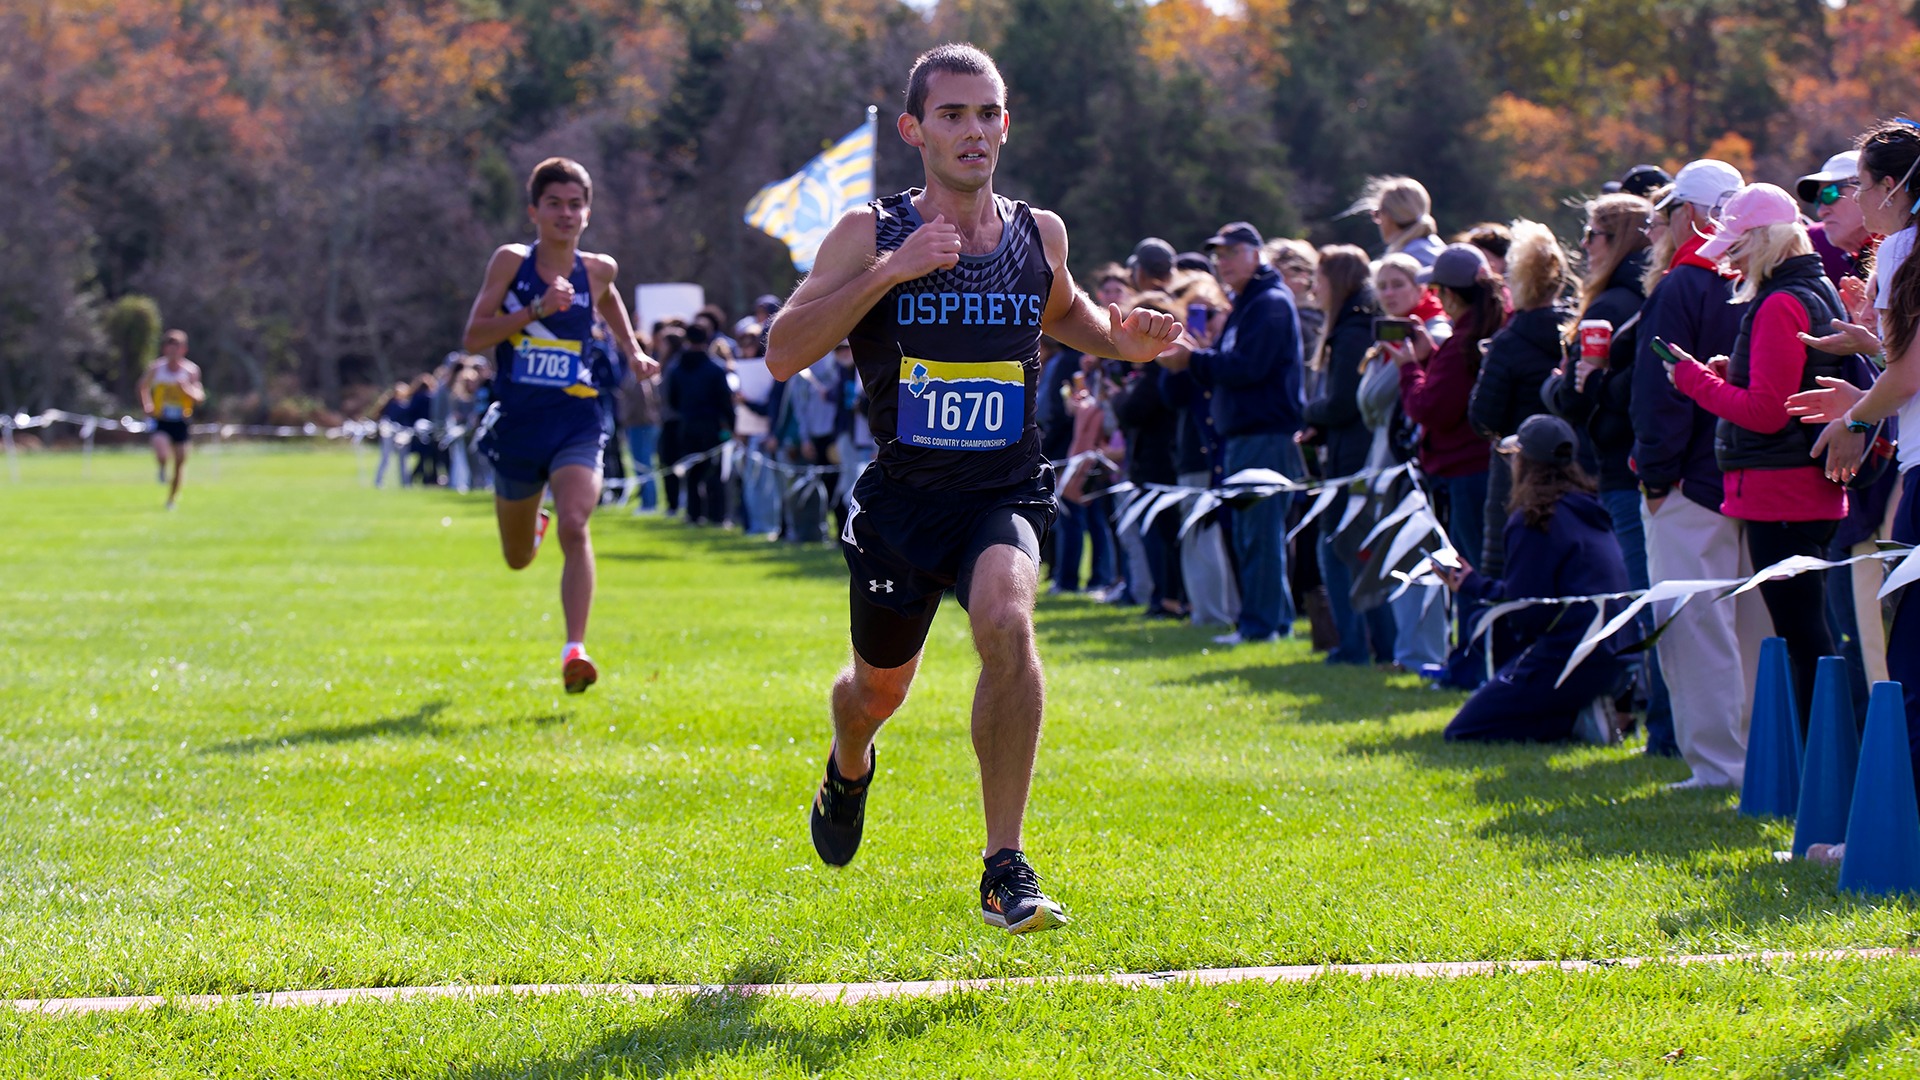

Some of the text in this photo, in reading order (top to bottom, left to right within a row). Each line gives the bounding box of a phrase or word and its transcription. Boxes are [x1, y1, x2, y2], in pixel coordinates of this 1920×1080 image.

[897, 292, 1042, 326] OSPREYS
[527, 351, 571, 379] 1703
[922, 390, 1004, 432] 1670
[912, 434, 1007, 448] CROSS COUNTRY CHAMPIONSHIPS
